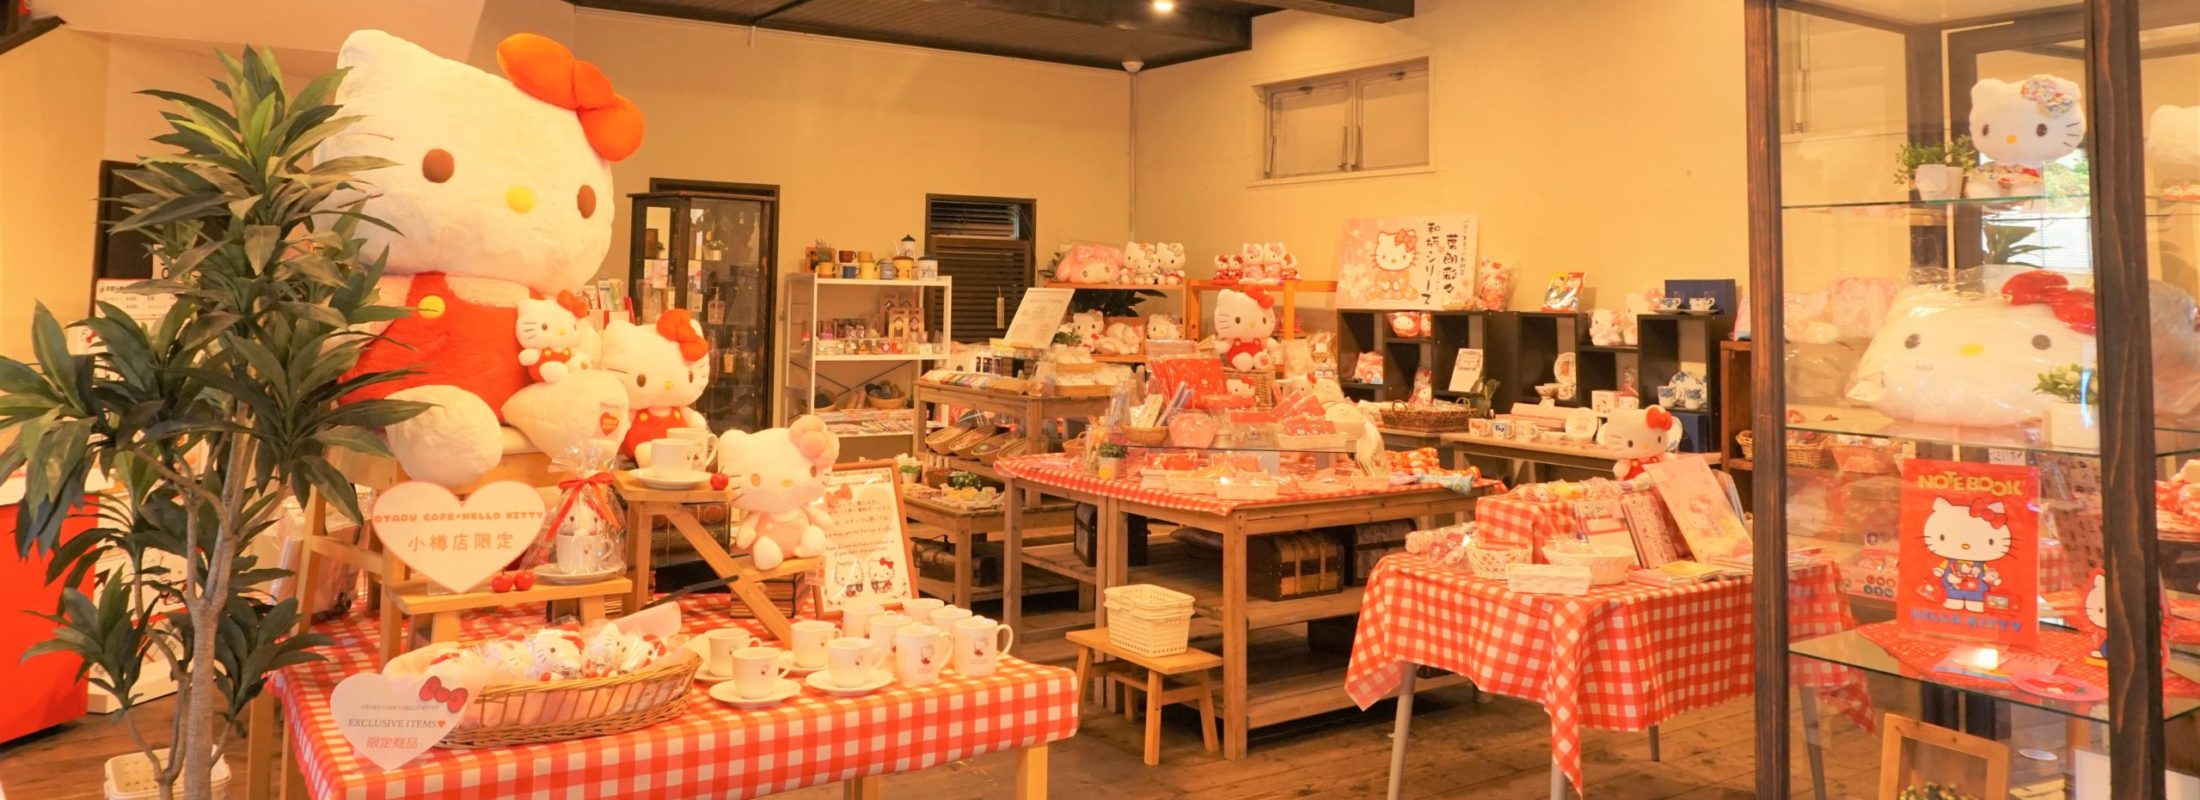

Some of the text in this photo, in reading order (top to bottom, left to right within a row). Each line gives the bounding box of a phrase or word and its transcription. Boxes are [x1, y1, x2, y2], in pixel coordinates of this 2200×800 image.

[374, 514, 417, 523] OTARU
[407, 532, 514, 552] 小樽店限定
[1910, 608, 2022, 633] HELLO KITTY
[348, 718, 437, 729] EXCLUSIVE ITEMS
[366, 736, 418, 749] 限定商品
